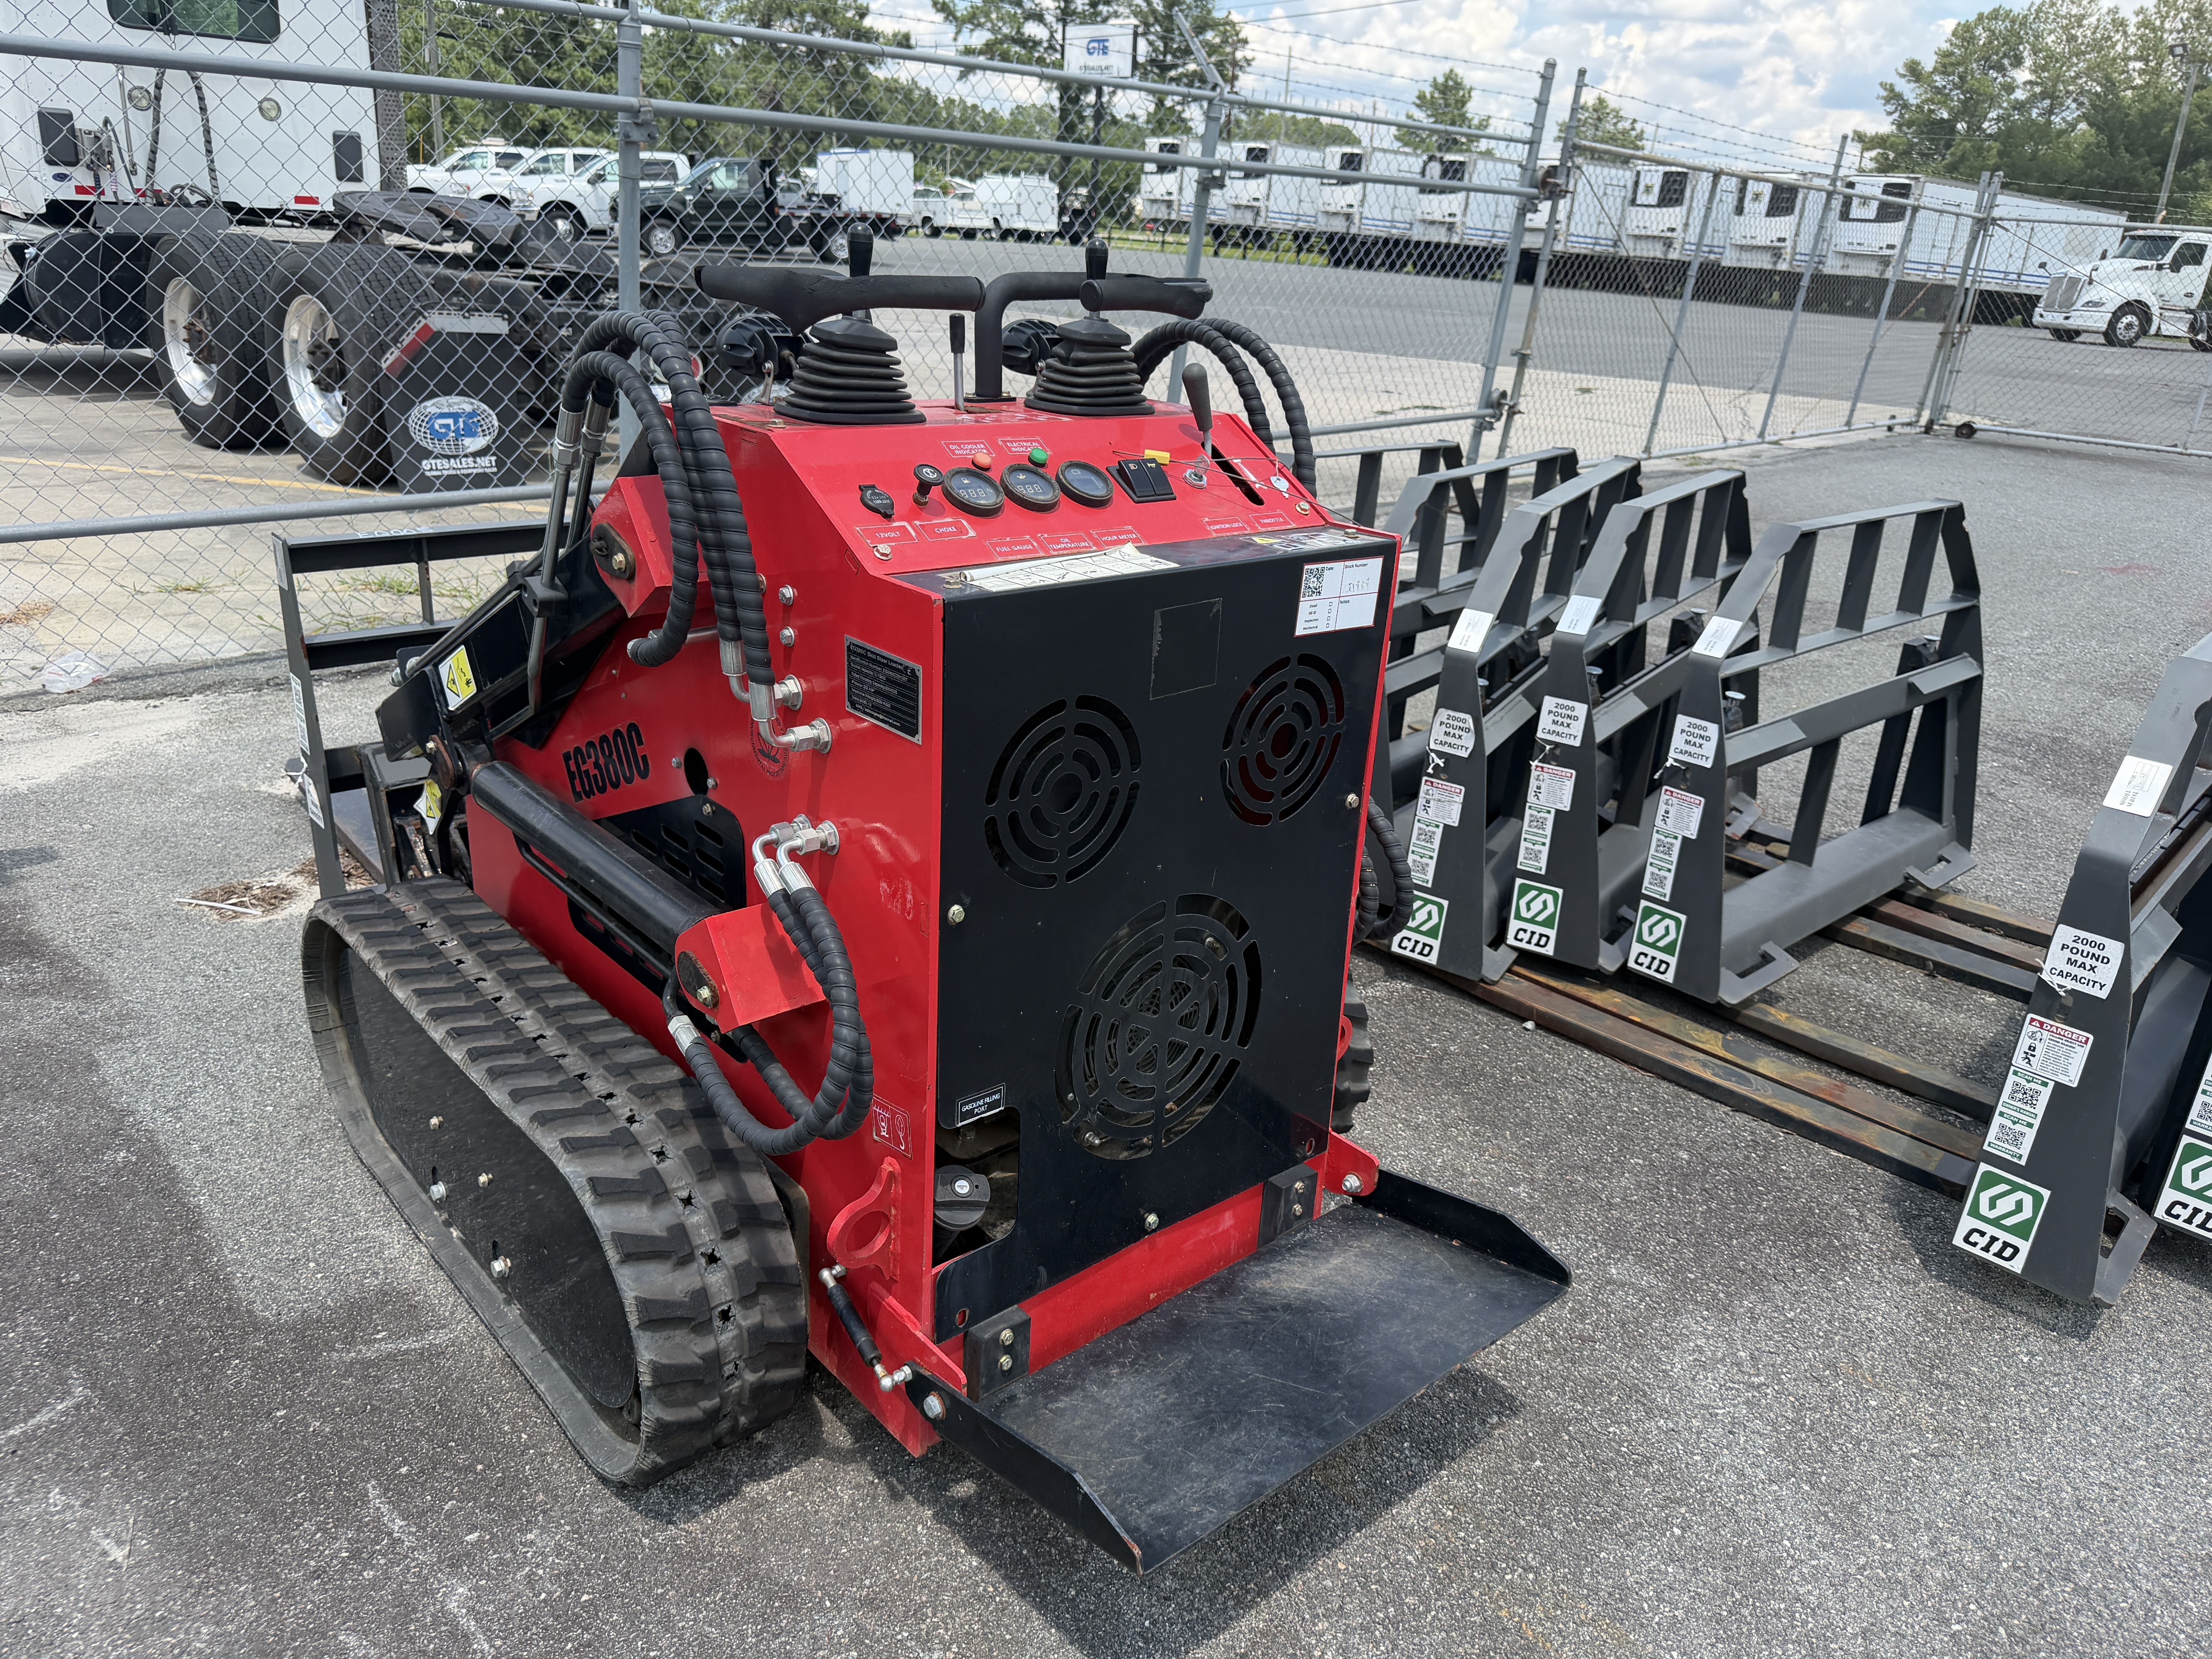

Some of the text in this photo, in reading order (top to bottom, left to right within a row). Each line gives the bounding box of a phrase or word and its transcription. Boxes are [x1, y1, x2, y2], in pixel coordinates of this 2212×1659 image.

[1087, 39, 1109, 56] GTE
[422, 456, 497, 470] GTESALES.NET
[1554, 702, 1575, 712] 2000
[1446, 714, 1467, 724] 2000
[1547, 709, 1578, 721] POUND
[1439, 721, 1470, 733] POUND
[1552, 719, 1572, 729] MAX
[1686, 721, 1707, 732] 2000
[1444, 731, 1463, 740] MAX
[1542, 728, 1578, 741] CAPACITY
[1680, 729, 1711, 742] POUND
[1434, 738, 1469, 752] CAPACITY
[1684, 738, 1704, 750] MAX
[1674, 747, 1709, 762] CAPACITY
[562, 722, 649, 803] EG380C
[1543, 767, 1571, 778] DANGER
[1433, 782, 1460, 793] DANGER
[1673, 792, 1700, 805] DANGER
[1513, 927, 1551, 948] CID
[2071, 935, 2106, 951] 2000
[1398, 936, 1434, 958] CID
[2060, 943, 2110, 965] POUND
[1633, 951, 1670, 975] CID
[2066, 957, 2098, 974] MAX
[2050, 967, 2107, 991] CAPACITY
[2042, 1023, 2086, 1043] DANGER
[2017, 1072, 2032, 1082] SCAN
[962, 1093, 1000, 1111] GASOLINE FILLING
[974, 1105, 988, 1114] PORT
[2003, 1113, 2018, 1123] SCAN
[1990, 1143, 2020, 1158] WARRANTY
[1962, 1228, 2020, 1262] CID
